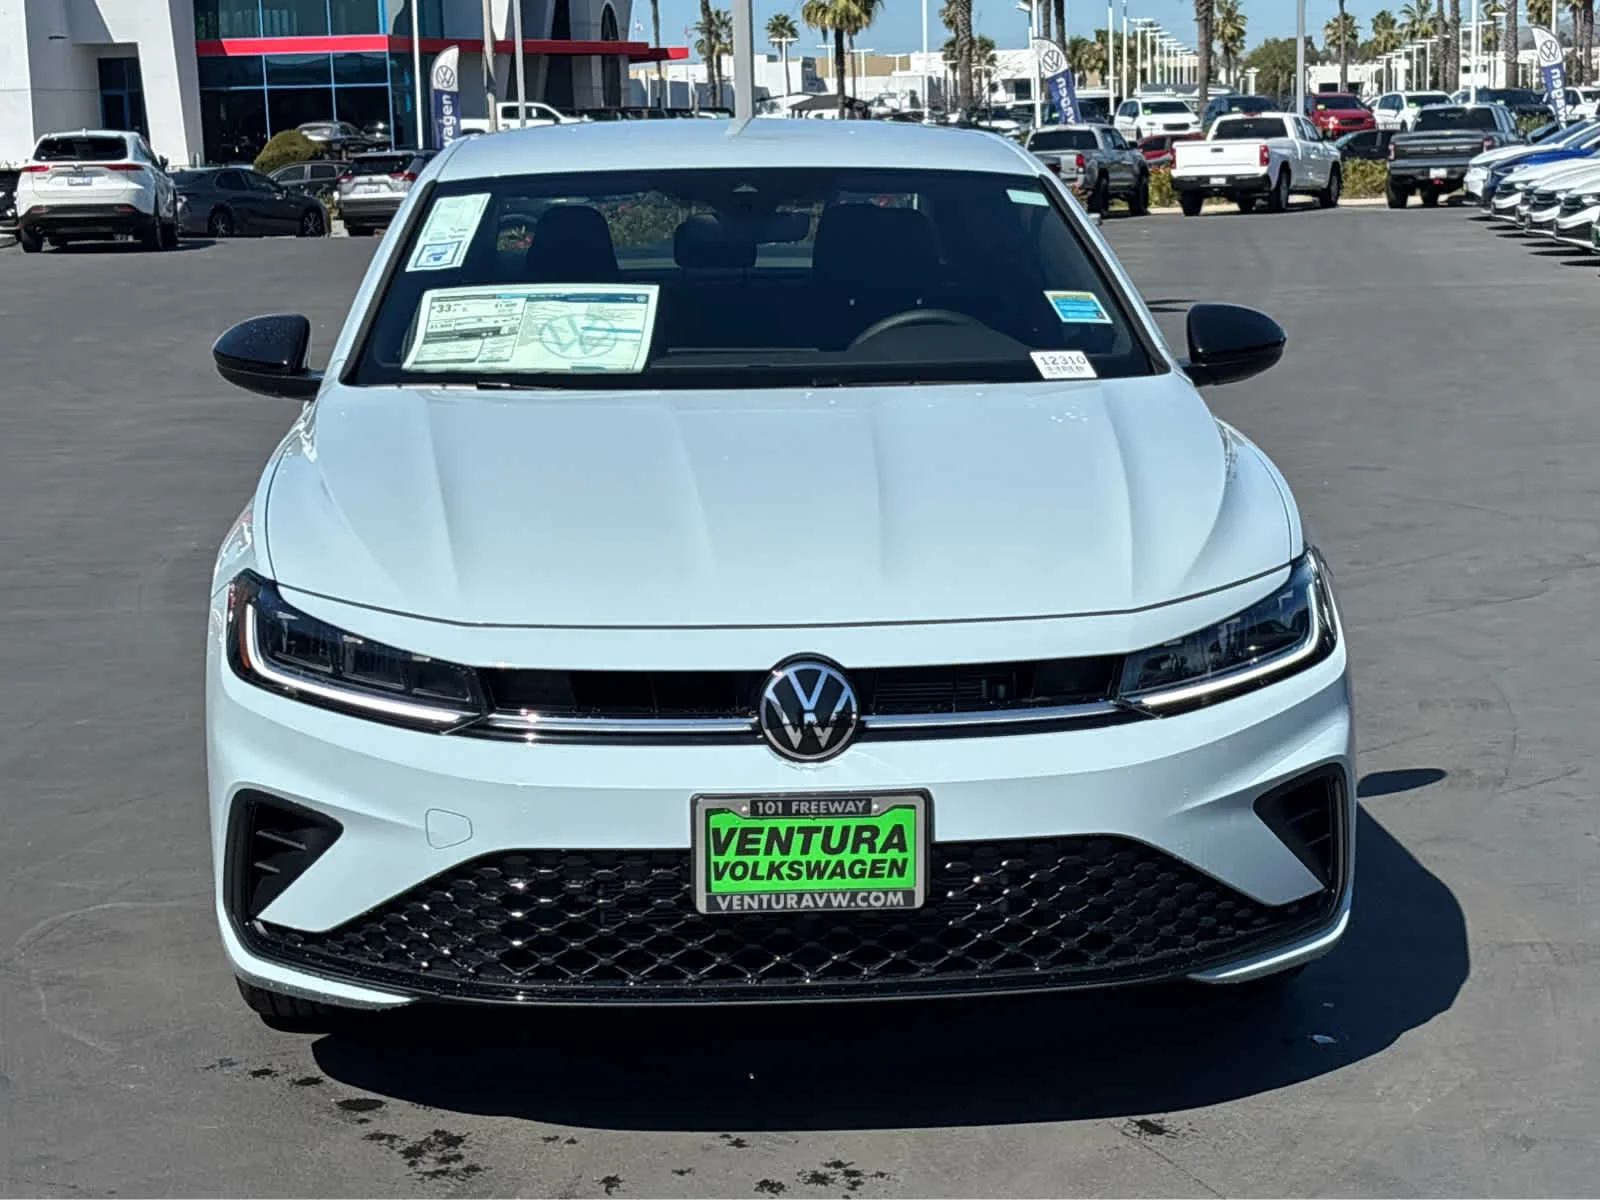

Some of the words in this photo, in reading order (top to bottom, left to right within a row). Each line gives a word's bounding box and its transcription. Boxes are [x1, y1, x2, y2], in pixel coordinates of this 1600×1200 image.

[1040, 355, 1086, 366] 12310
[756, 801, 783, 814] 101
[791, 800, 866, 814] FREEWAY
[711, 824, 908, 856] VENTURA
[712, 858, 908, 881] VOLKSWAGEN
[716, 891, 905, 910] VENTURAVW.COM
